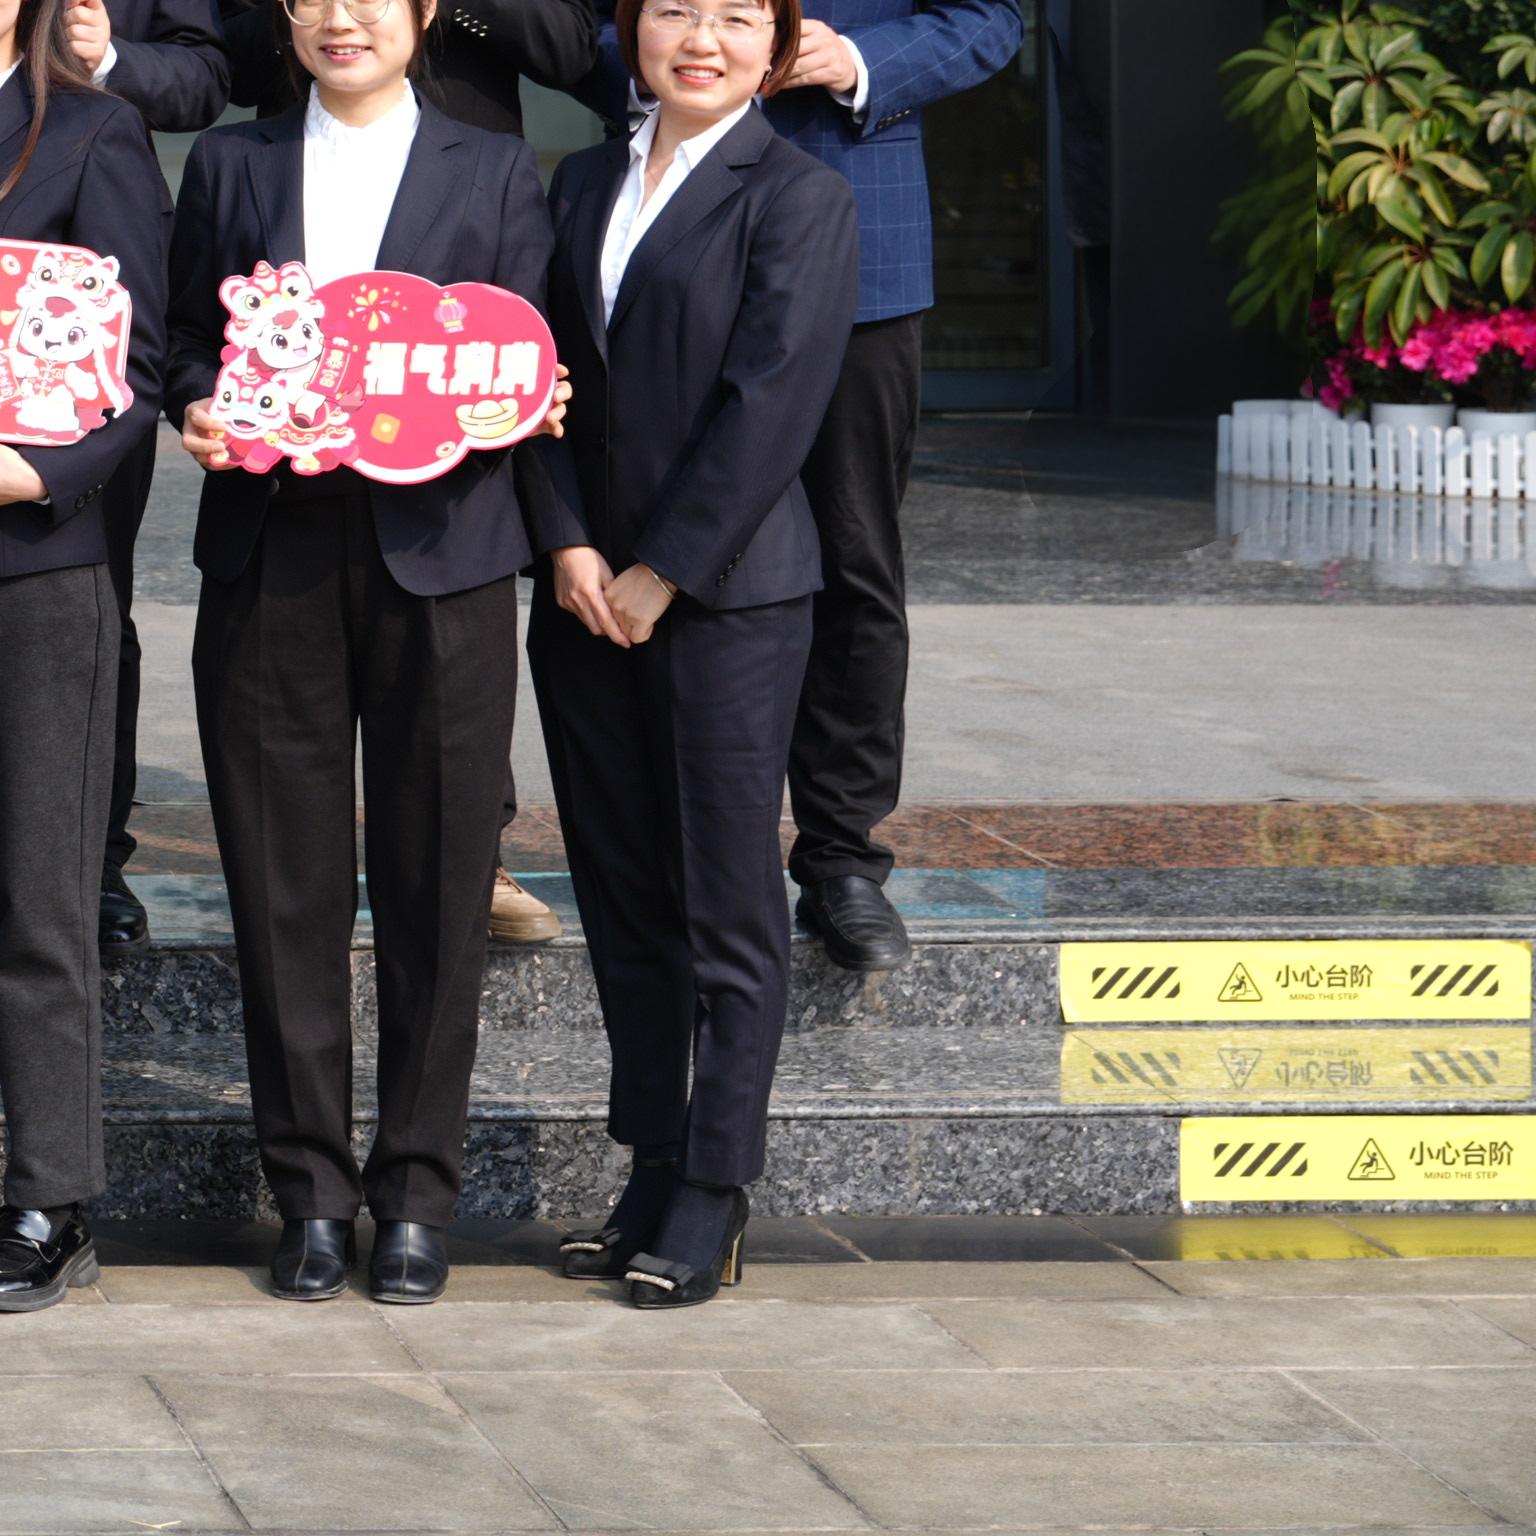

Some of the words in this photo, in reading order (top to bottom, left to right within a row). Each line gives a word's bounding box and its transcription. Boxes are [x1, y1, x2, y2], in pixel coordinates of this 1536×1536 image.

[363, 341, 541, 395] 福气满满
[1275, 963, 1374, 989] 小心台阶
[1289, 993, 1315, 1001] MIND
[1318, 993, 1334, 1001] THE
[1338, 992, 1359, 1001] STEP
[1409, 1140, 1514, 1166] 小心台阶
[1424, 1171, 1452, 1180] MIND
[1455, 1171, 1473, 1180] THE
[1476, 1171, 1499, 1180] STEP
